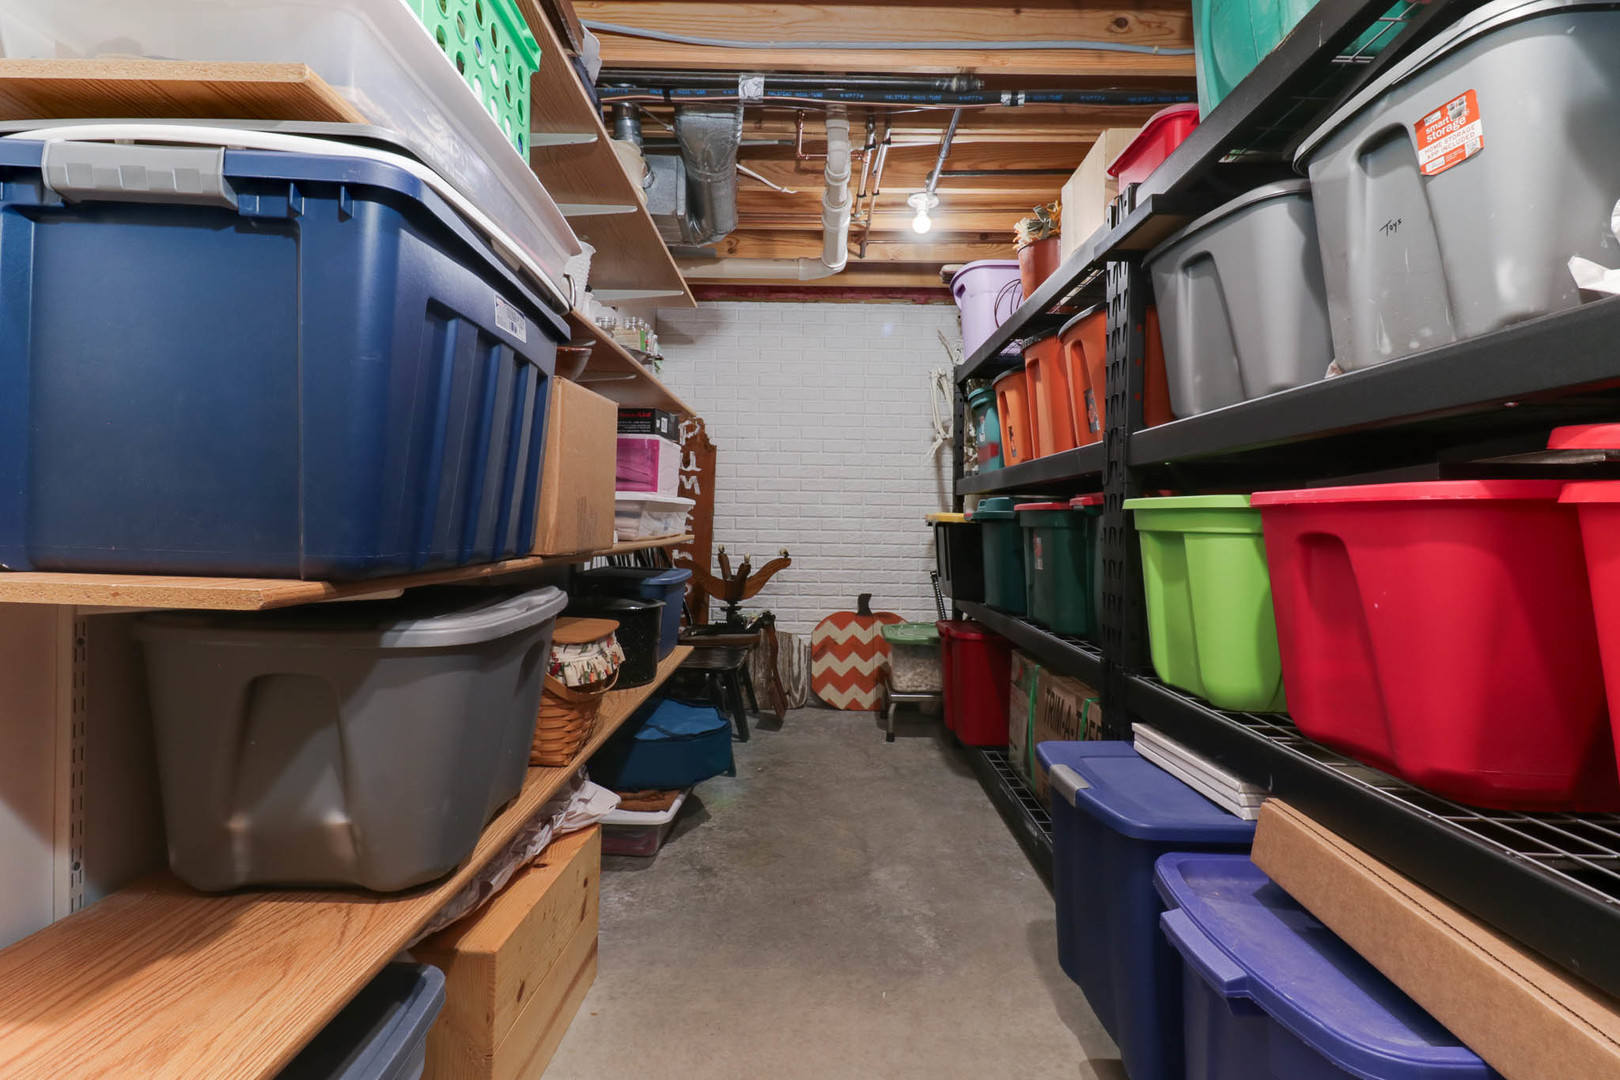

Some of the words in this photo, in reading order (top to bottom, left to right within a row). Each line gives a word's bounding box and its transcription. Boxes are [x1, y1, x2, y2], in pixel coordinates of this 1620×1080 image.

[1425, 116, 1449, 135] smart
[1425, 141, 1443, 154] HOME
[1444, 124, 1475, 144] STORAGE
[1426, 116, 1466, 143] storage
[1428, 148, 1440, 159] APP
[1441, 131, 1475, 152] INCLUDED
[1379, 217, 1402, 236] Toys
